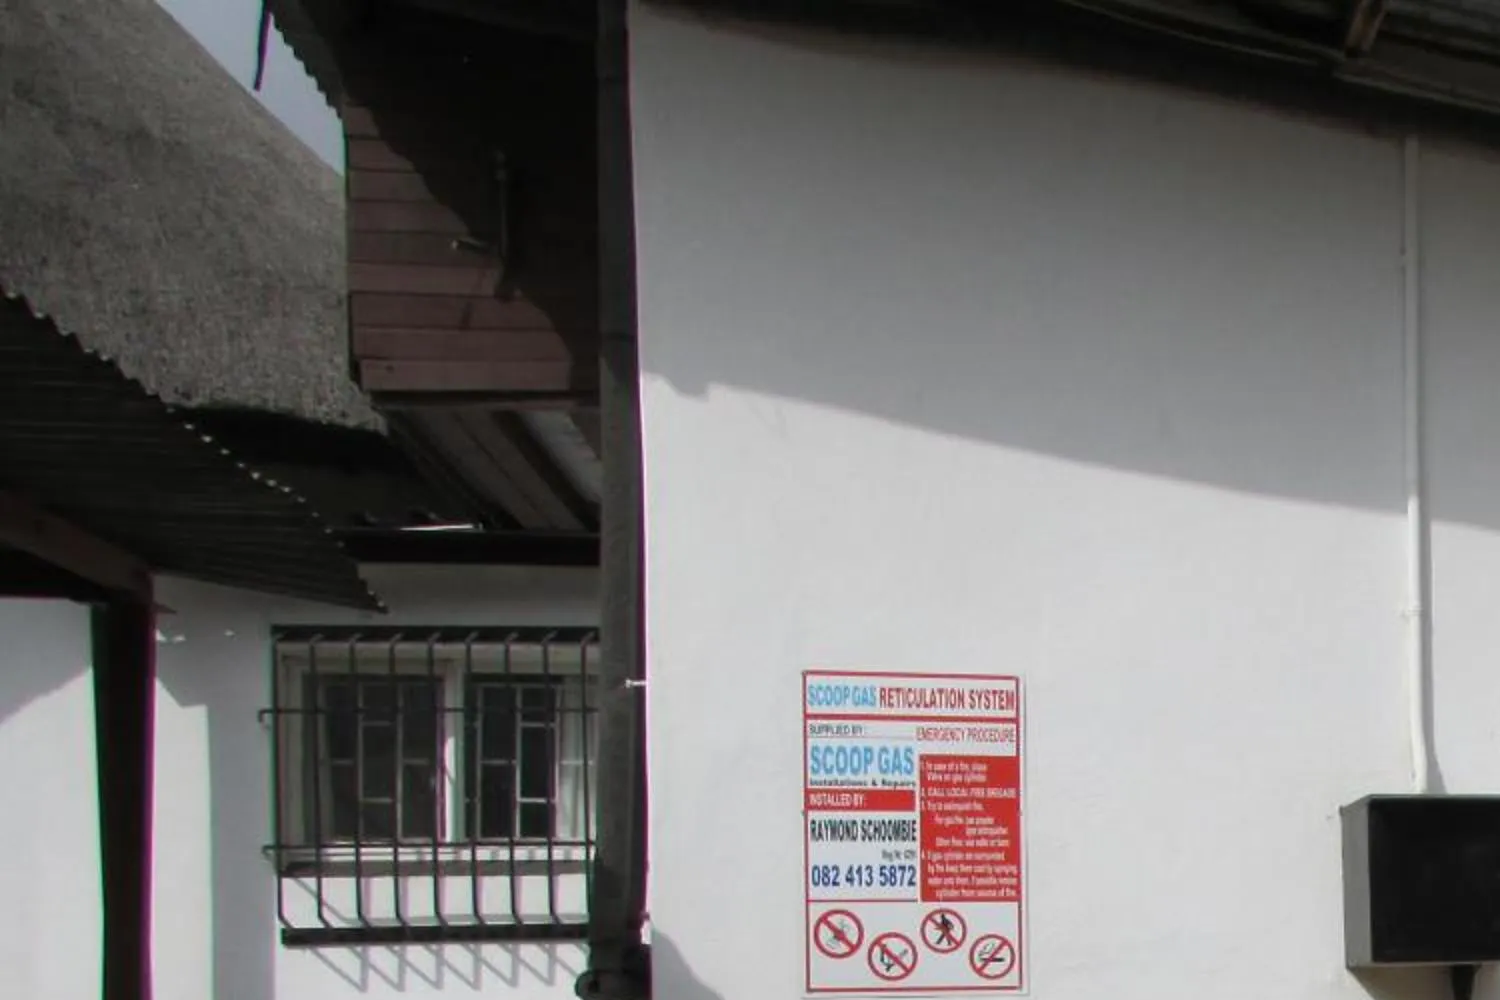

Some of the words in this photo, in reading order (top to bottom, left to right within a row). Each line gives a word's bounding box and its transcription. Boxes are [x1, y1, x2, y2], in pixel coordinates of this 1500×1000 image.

[808, 684, 849, 707] SCOOP
[854, 686, 876, 708] GAS
[879, 687, 965, 709] RETICULATION
[969, 689, 1014, 711] SYSTEM
[916, 726, 964, 742] EMERGENCY
[967, 727, 1015, 743] PROCEDURE
[811, 745, 873, 775] SCOOP
[878, 746, 914, 775] GAS
[810, 793, 852, 806] INSTALLED
[810, 819, 858, 842] RAYMOND
[860, 820, 917, 842] SCHOOMBIE
[811, 865, 840, 887] 082
[845, 865, 874, 887] 413
[879, 865, 916, 887] 5872
